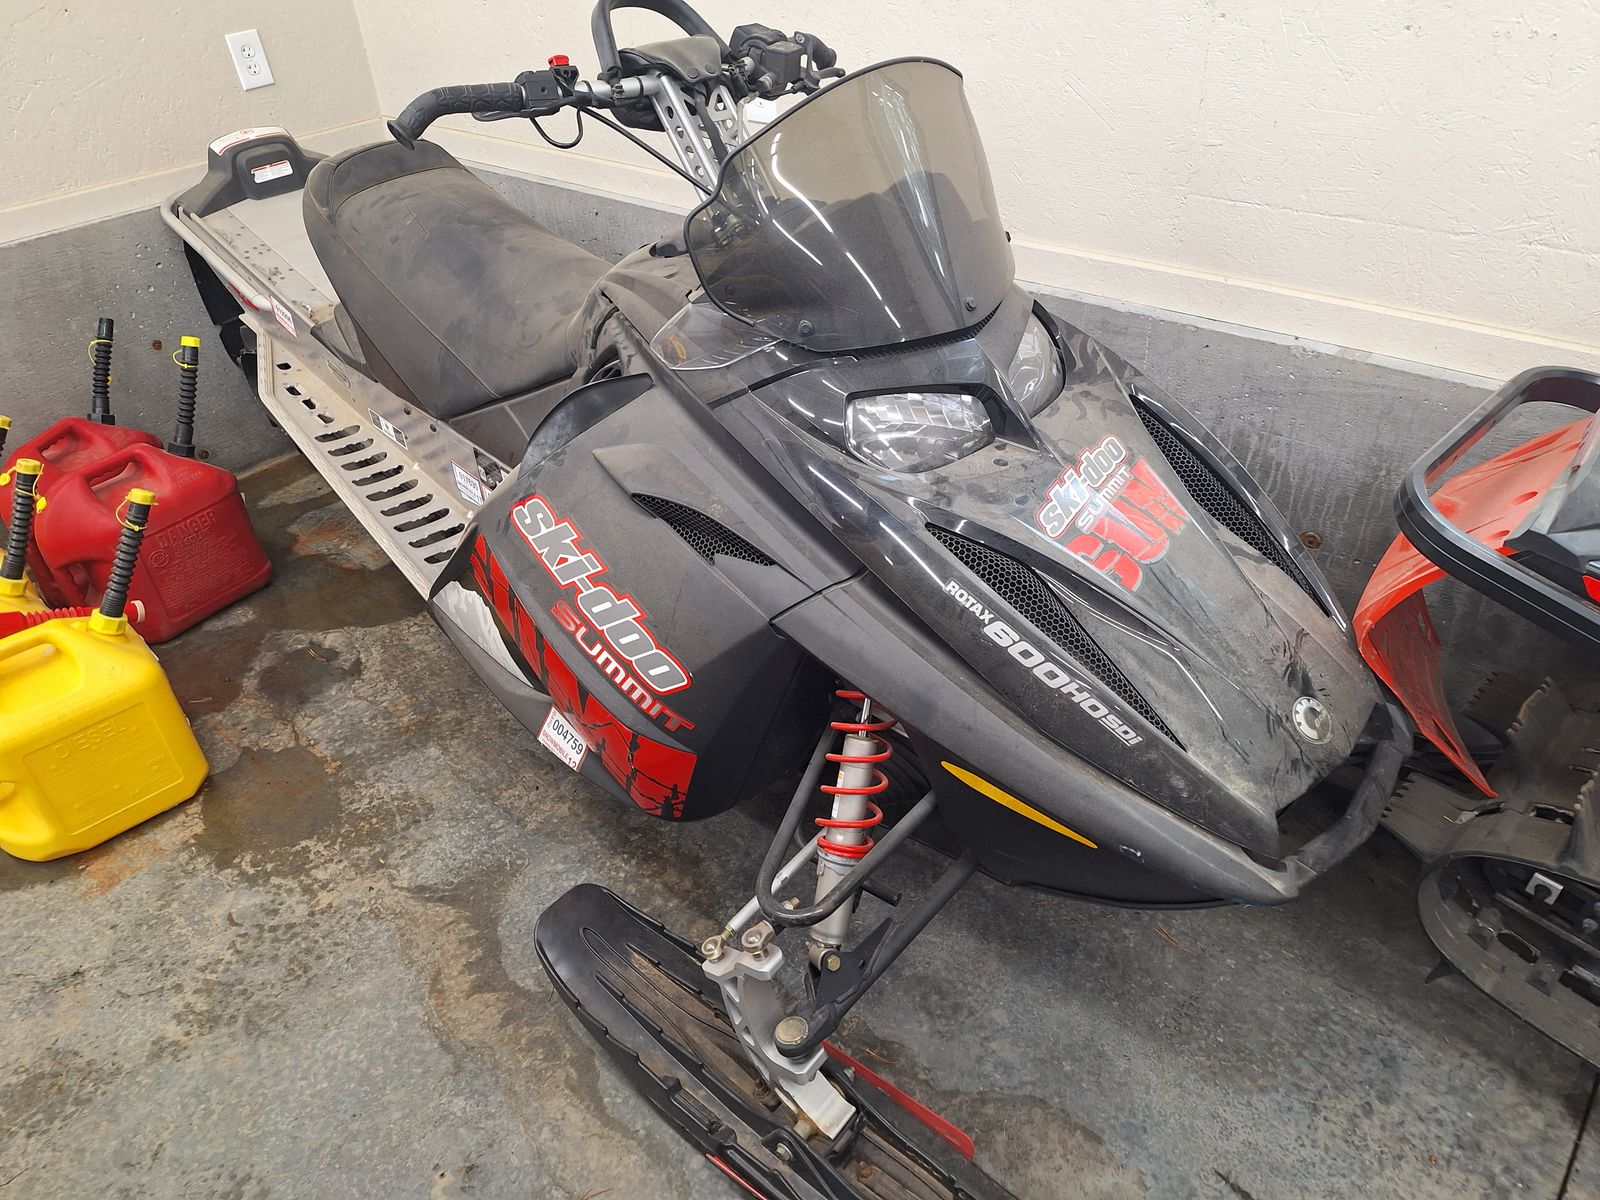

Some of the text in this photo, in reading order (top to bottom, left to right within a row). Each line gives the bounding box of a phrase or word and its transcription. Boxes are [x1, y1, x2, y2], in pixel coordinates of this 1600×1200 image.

[945, 580, 995, 625] ROTAX
[54, 719, 129, 759] DIESEL
[542, 729, 569, 760] SNOWMOBILE
[552, 719, 584, 755] 004759
